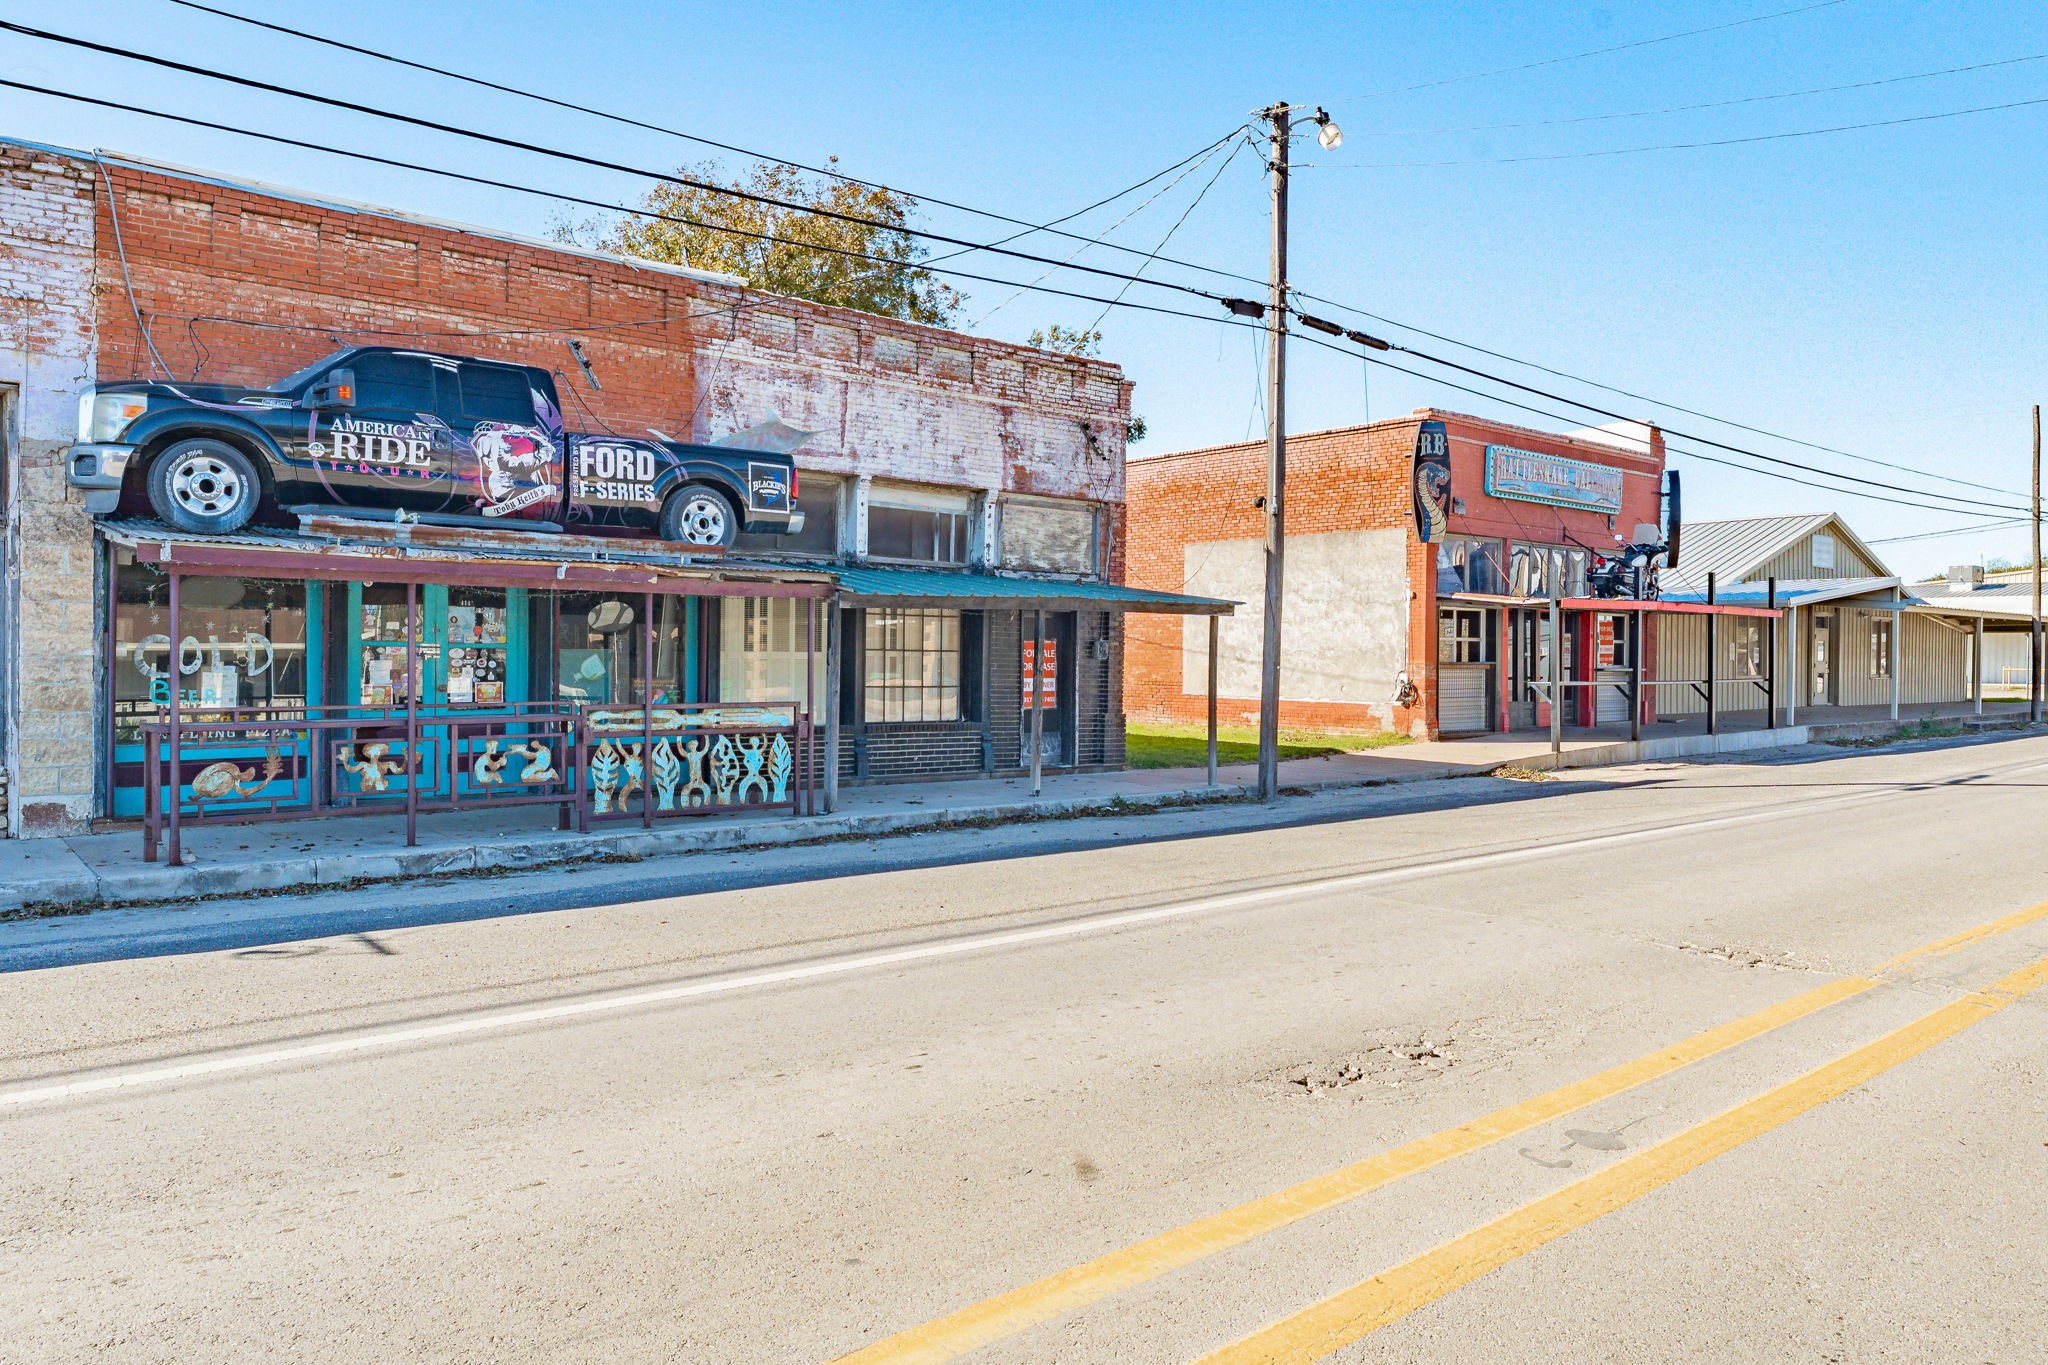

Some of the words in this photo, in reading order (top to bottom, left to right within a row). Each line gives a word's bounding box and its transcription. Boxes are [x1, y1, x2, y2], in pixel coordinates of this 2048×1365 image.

[330, 418, 430, 440] AMERICAN
[330, 431, 431, 467] RIDE
[580, 445, 655, 481] FORD
[493, 501, 516, 516] Toby
[517, 488, 546, 505] Keith's
[134, 633, 274, 678] COLD
[179, 730, 236, 739] FLING
